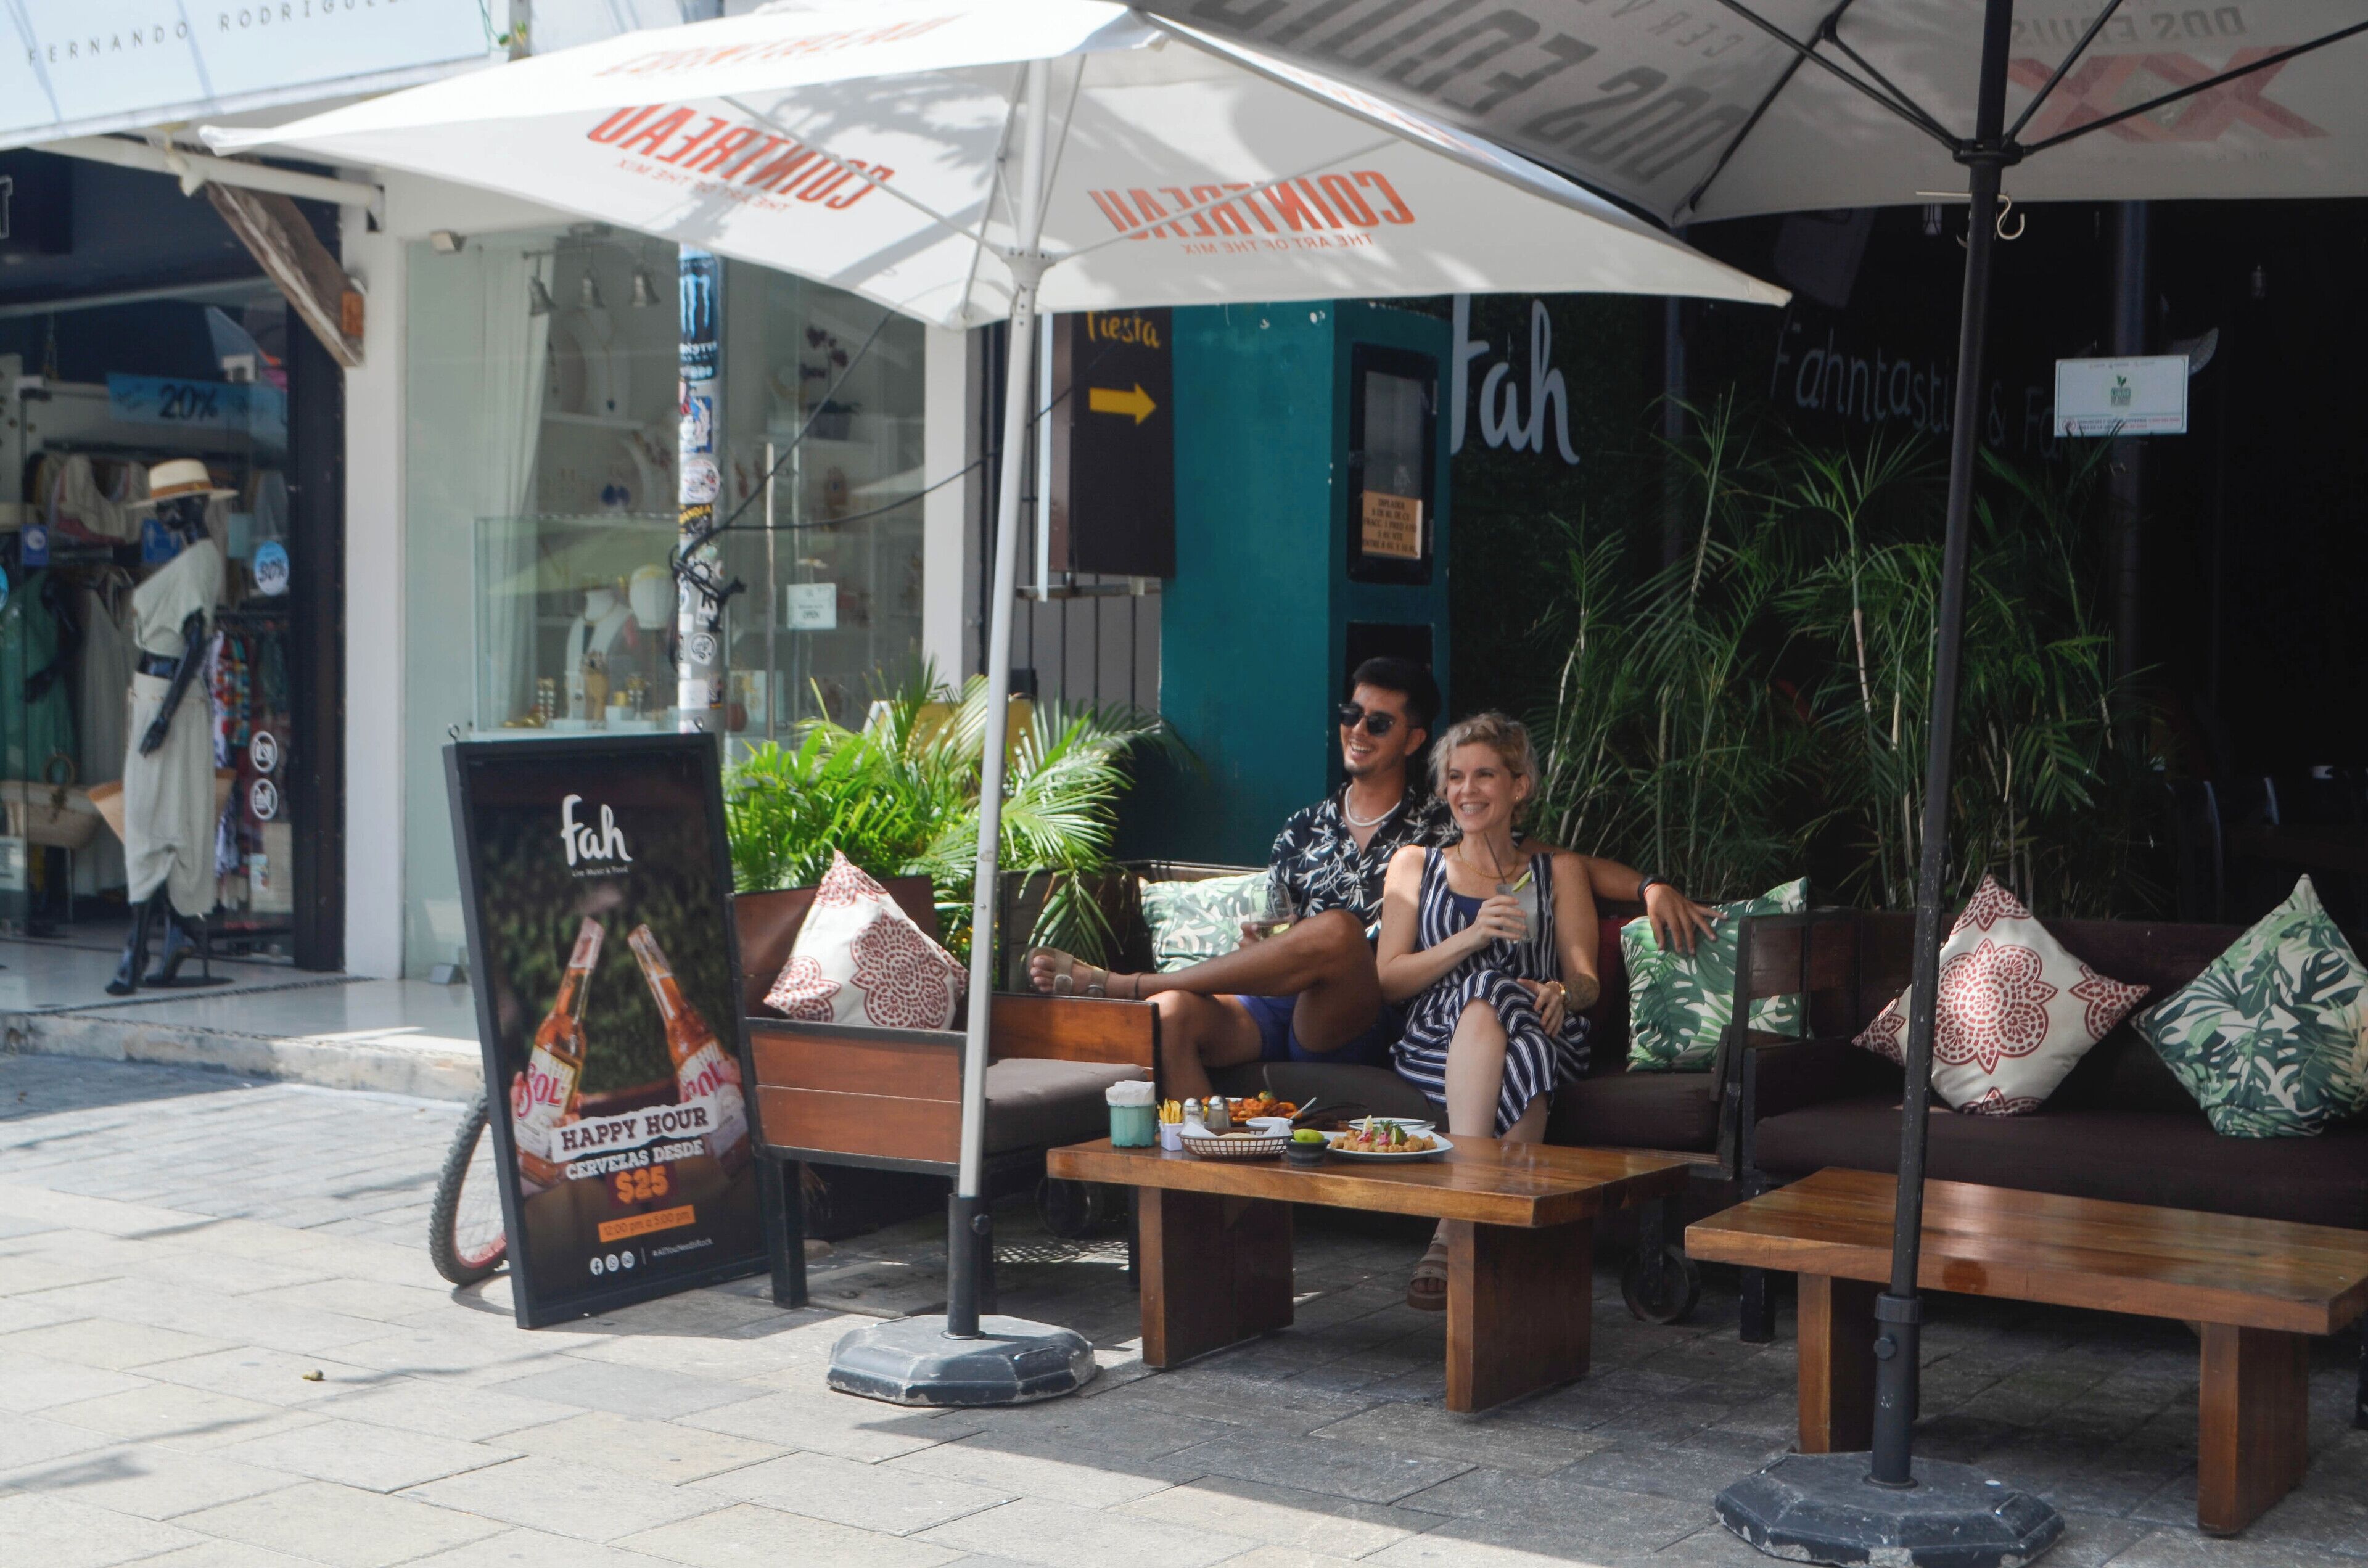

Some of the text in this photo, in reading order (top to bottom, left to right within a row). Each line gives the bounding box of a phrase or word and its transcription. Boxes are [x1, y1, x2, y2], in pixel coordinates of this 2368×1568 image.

[27, 0, 400, 66] FERNANDO RODRIGU
[158, 383, 218, 422] 20%
[1770, 328, 1951, 434] Fahntasti
[561, 1118, 638, 1152] HAPPY
[644, 1106, 709, 1136] HOUR
[565, 1139, 704, 1180] CERVEZAS DESDE
[614, 1164, 670, 1204] $25
